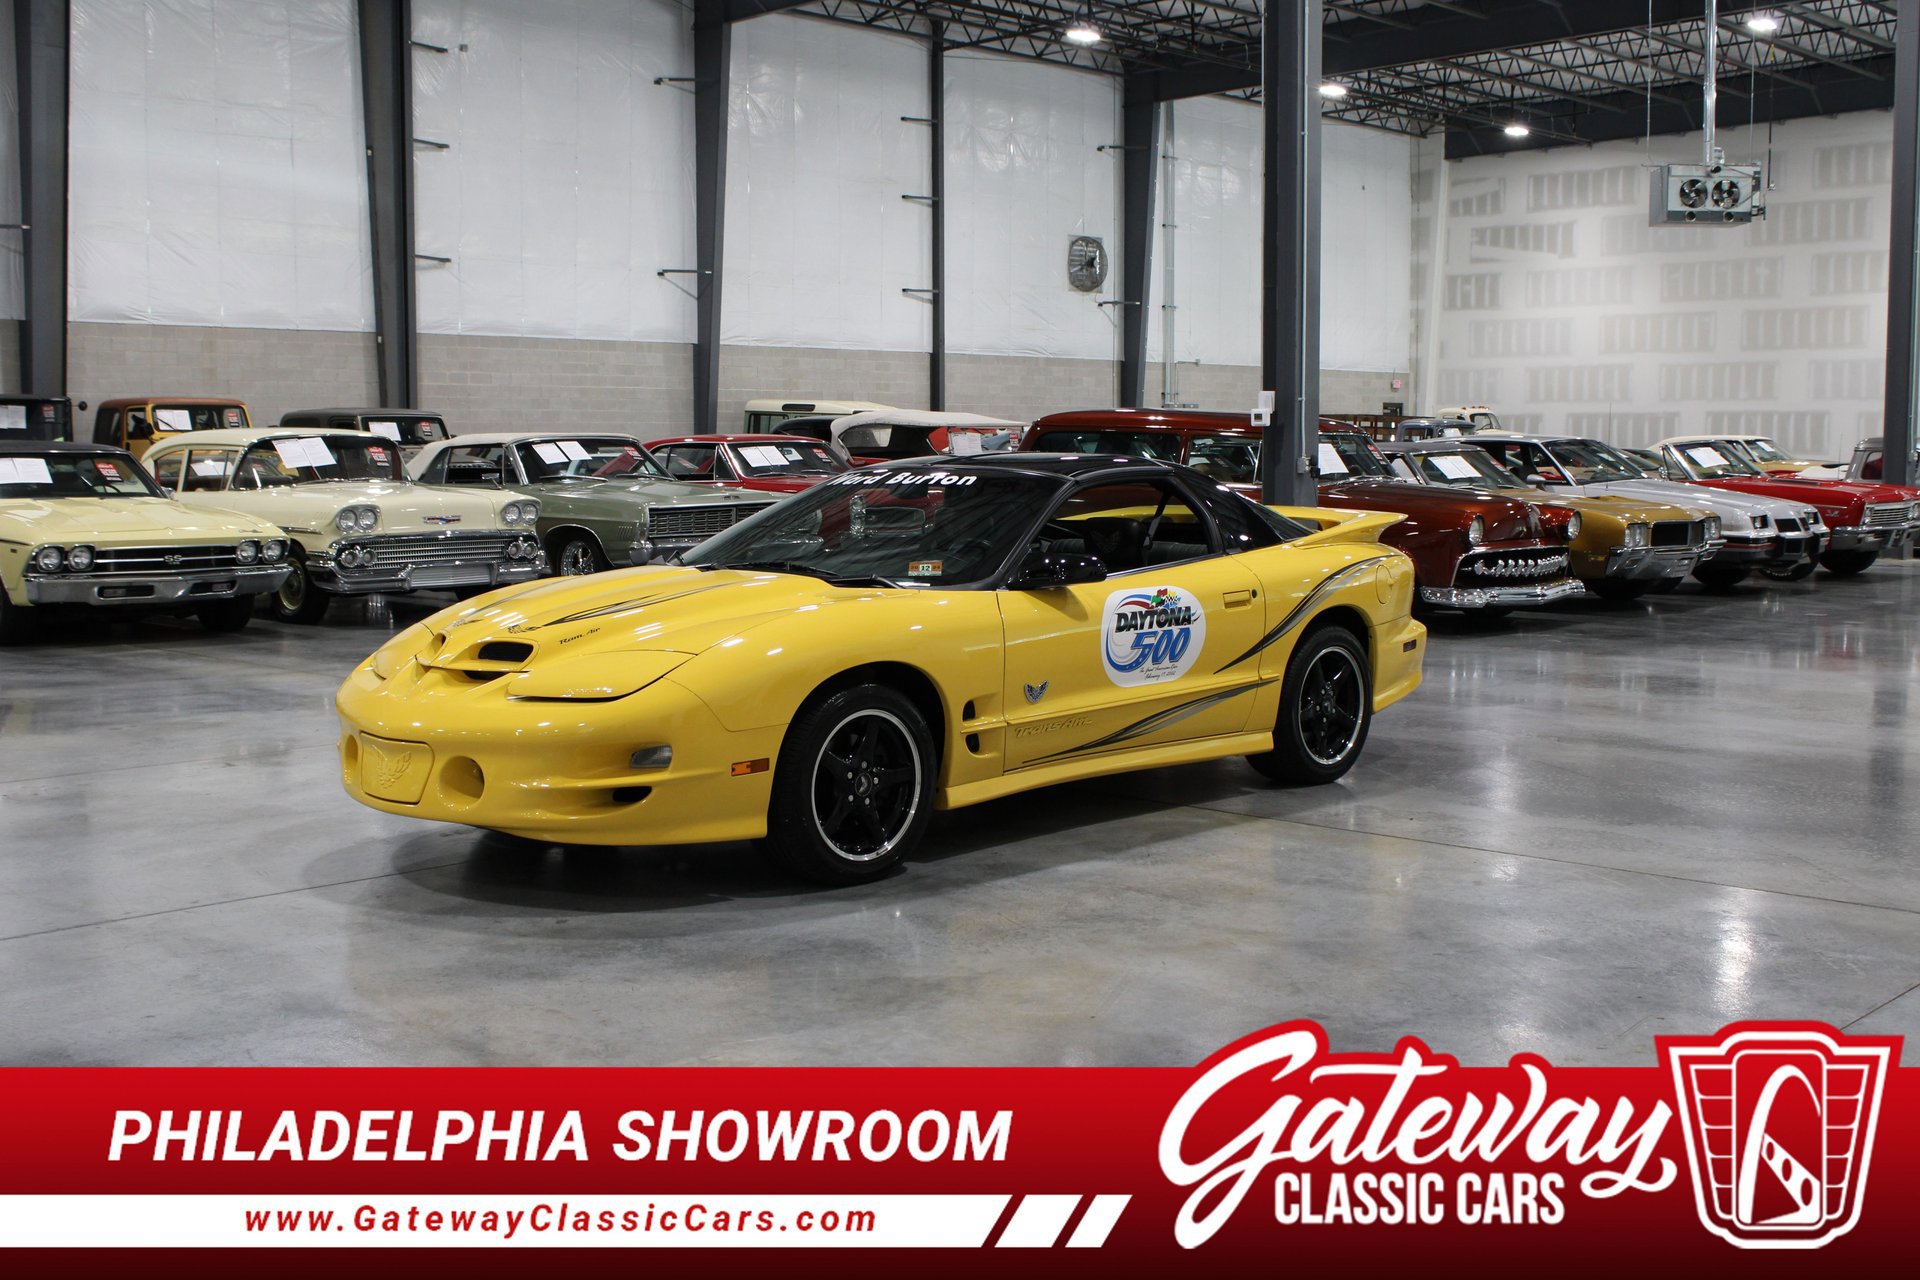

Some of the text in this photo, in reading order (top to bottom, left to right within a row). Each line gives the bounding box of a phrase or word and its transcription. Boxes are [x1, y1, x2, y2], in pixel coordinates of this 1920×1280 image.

[885, 471, 978, 486] Burton
[1115, 605, 1192, 633] DAYTONA
[560, 634, 583, 645] Ram
[1131, 627, 1191, 666] 500
